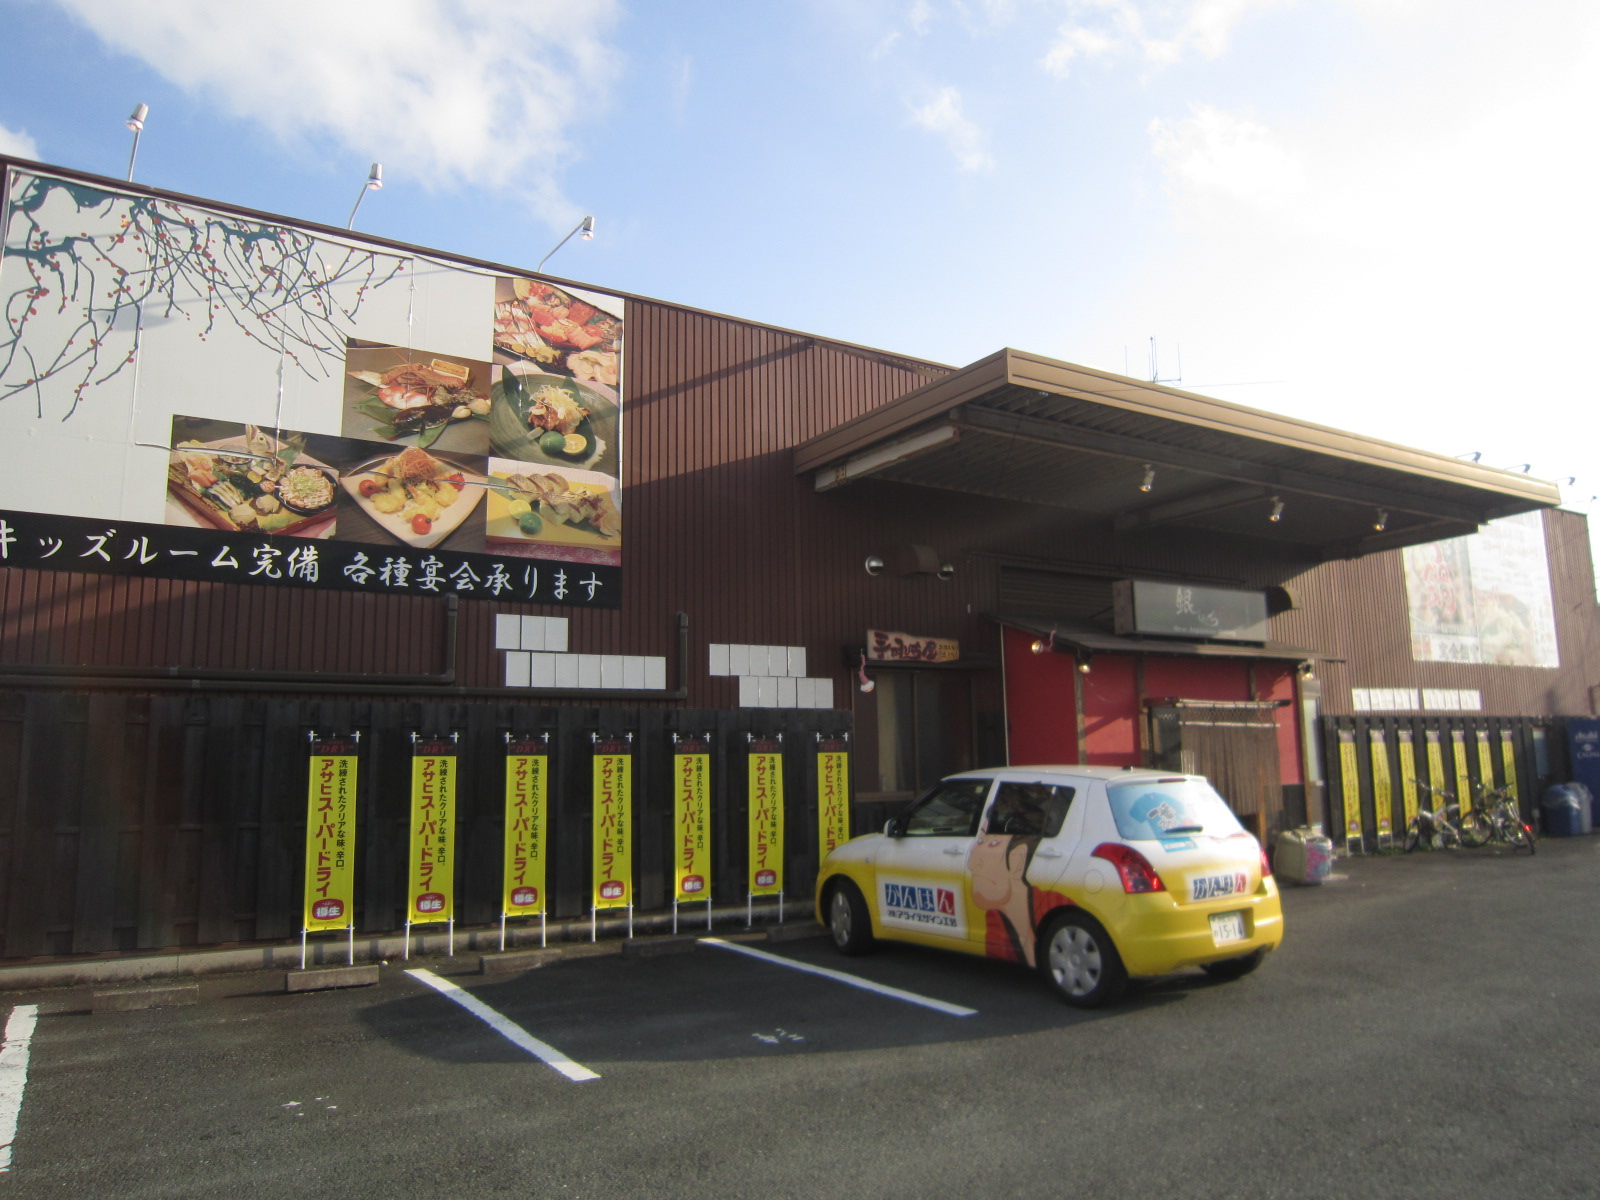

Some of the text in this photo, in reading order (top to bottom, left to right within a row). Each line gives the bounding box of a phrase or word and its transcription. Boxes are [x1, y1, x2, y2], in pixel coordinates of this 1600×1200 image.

[343, 551, 604, 601] 各種宴会承ります
[316, 759, 335, 897] アサヒスーパードライ
[419, 759, 437, 891] アサヒスーパードライ
[513, 758, 530, 885] アサヒスーパードライ
[601, 757, 616, 879] アサヒスーパードライ
[682, 757, 696, 873] アサヒスーパードライ
[755, 756, 769, 868] アサヒスーパードライ
